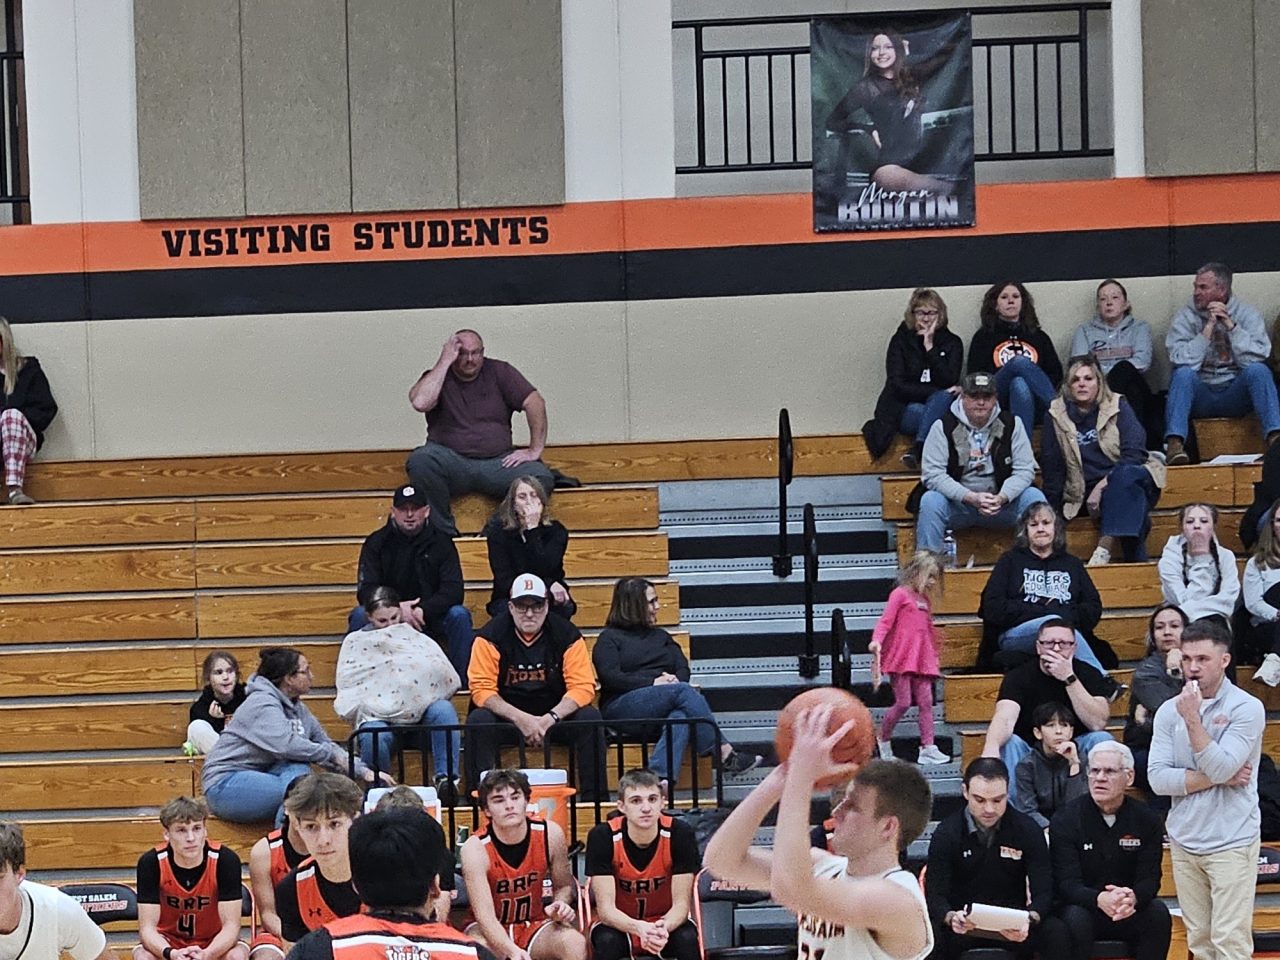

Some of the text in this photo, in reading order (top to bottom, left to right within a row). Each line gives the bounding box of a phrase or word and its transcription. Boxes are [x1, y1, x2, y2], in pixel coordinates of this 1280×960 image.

[858, 181, 934, 208] Morgan
[161, 215, 549, 258] VISITING STUDENTS
[496, 871, 540, 895] BRF
[620, 878, 666, 895] BRF
[166, 895, 211, 911] BRF
[501, 894, 532, 924] 10
[177, 912, 197, 939] 4
